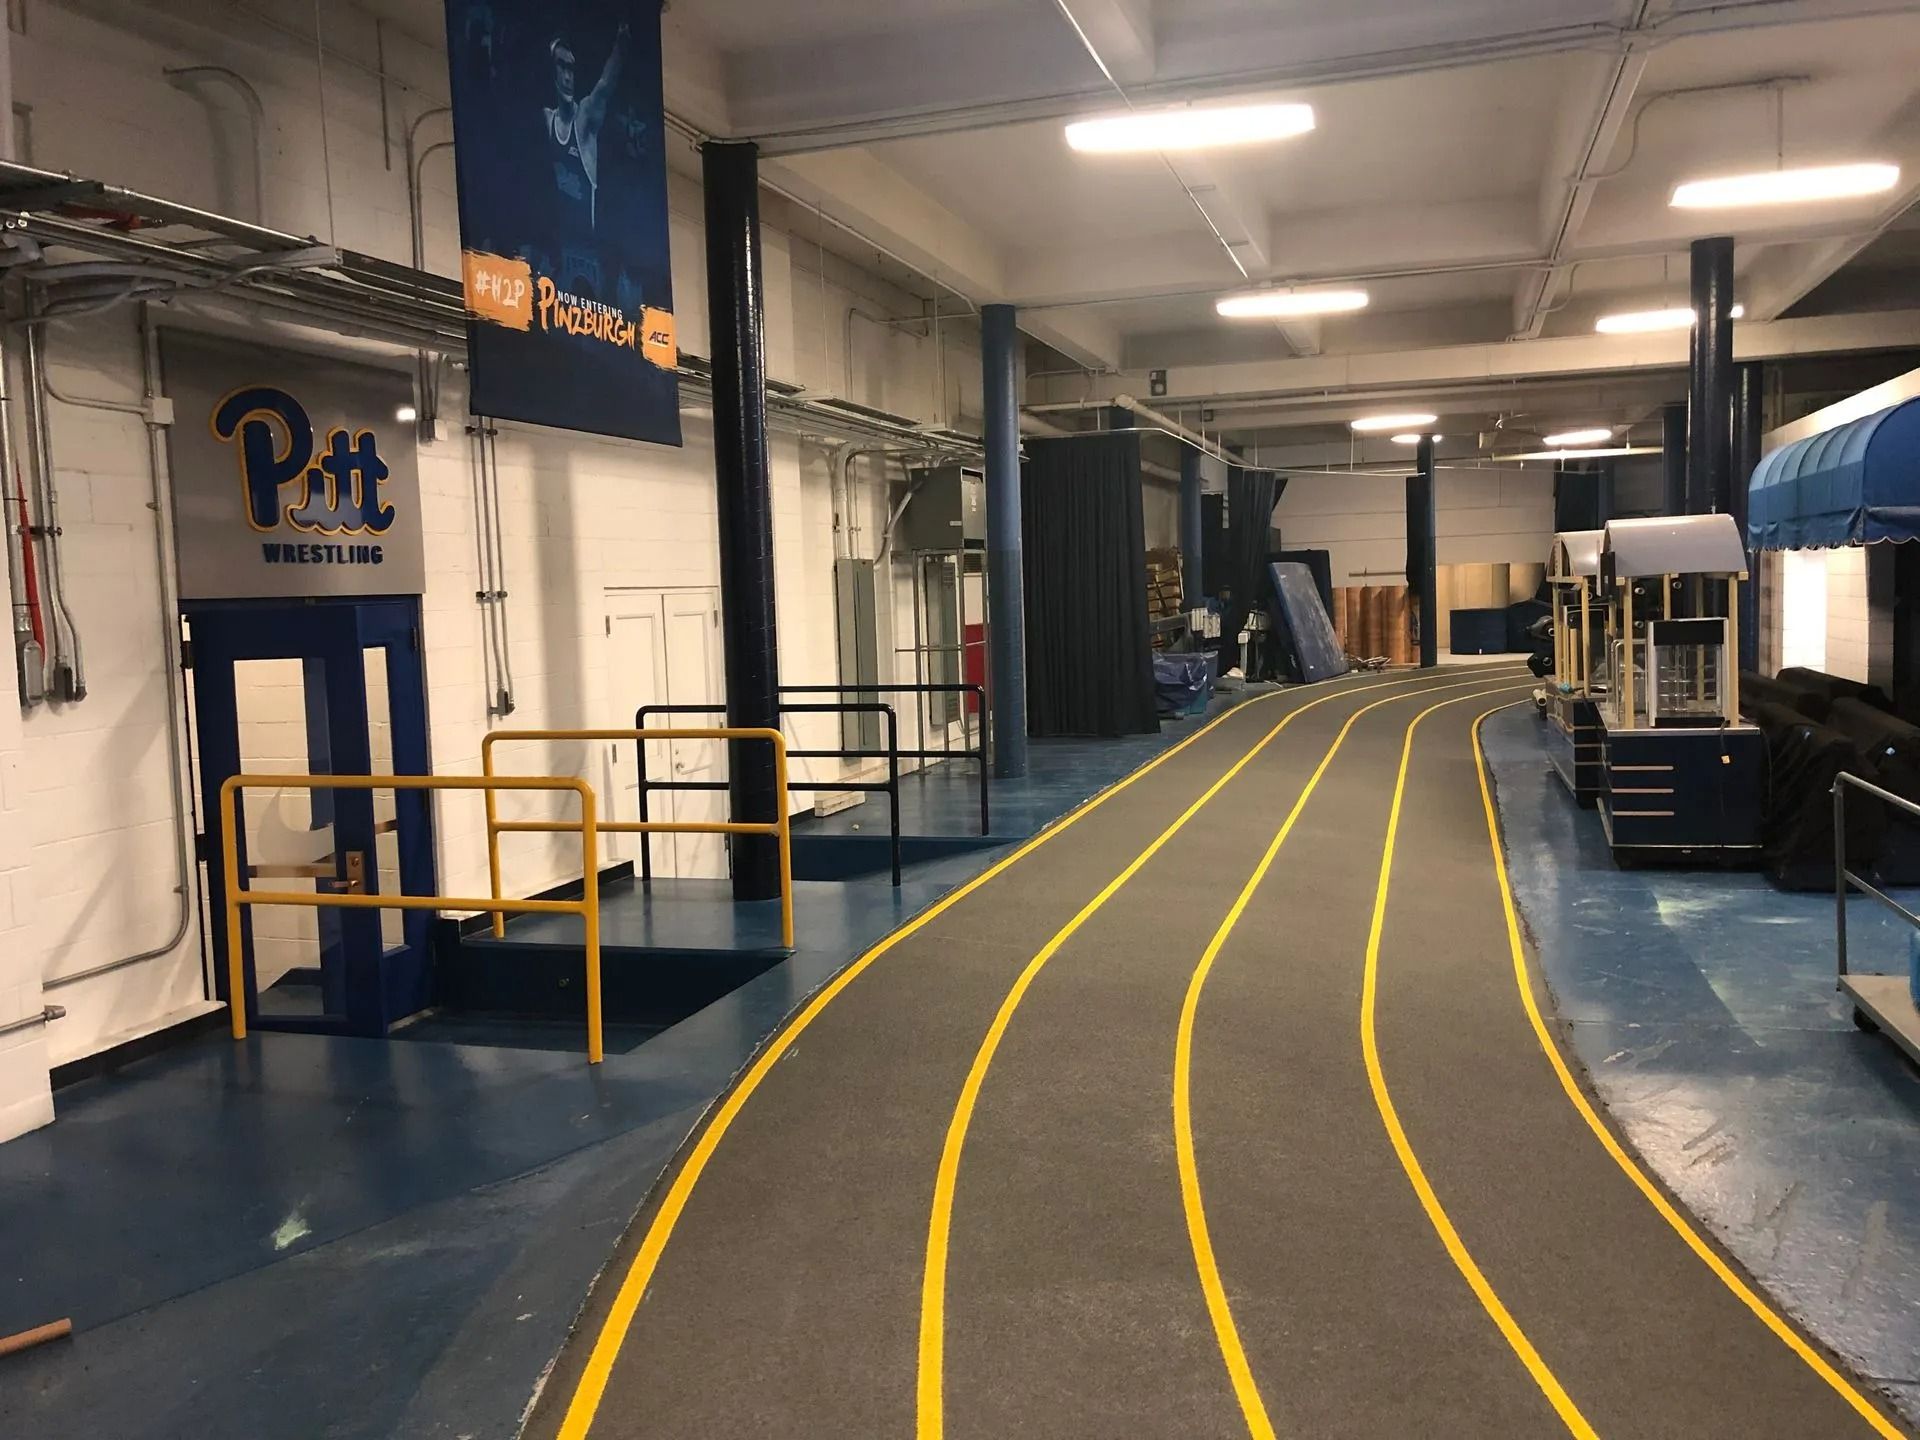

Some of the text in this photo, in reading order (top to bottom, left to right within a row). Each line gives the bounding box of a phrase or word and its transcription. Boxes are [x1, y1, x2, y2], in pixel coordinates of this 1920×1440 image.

[475, 270, 525, 308] #H2P
[557, 290, 623, 320] NOW ENTERING
[538, 276, 635, 350] PINZBURGH
[649, 330, 669, 345] ACC
[210, 384, 395, 535] Pitt
[263, 543, 384, 564] WRESTLING
